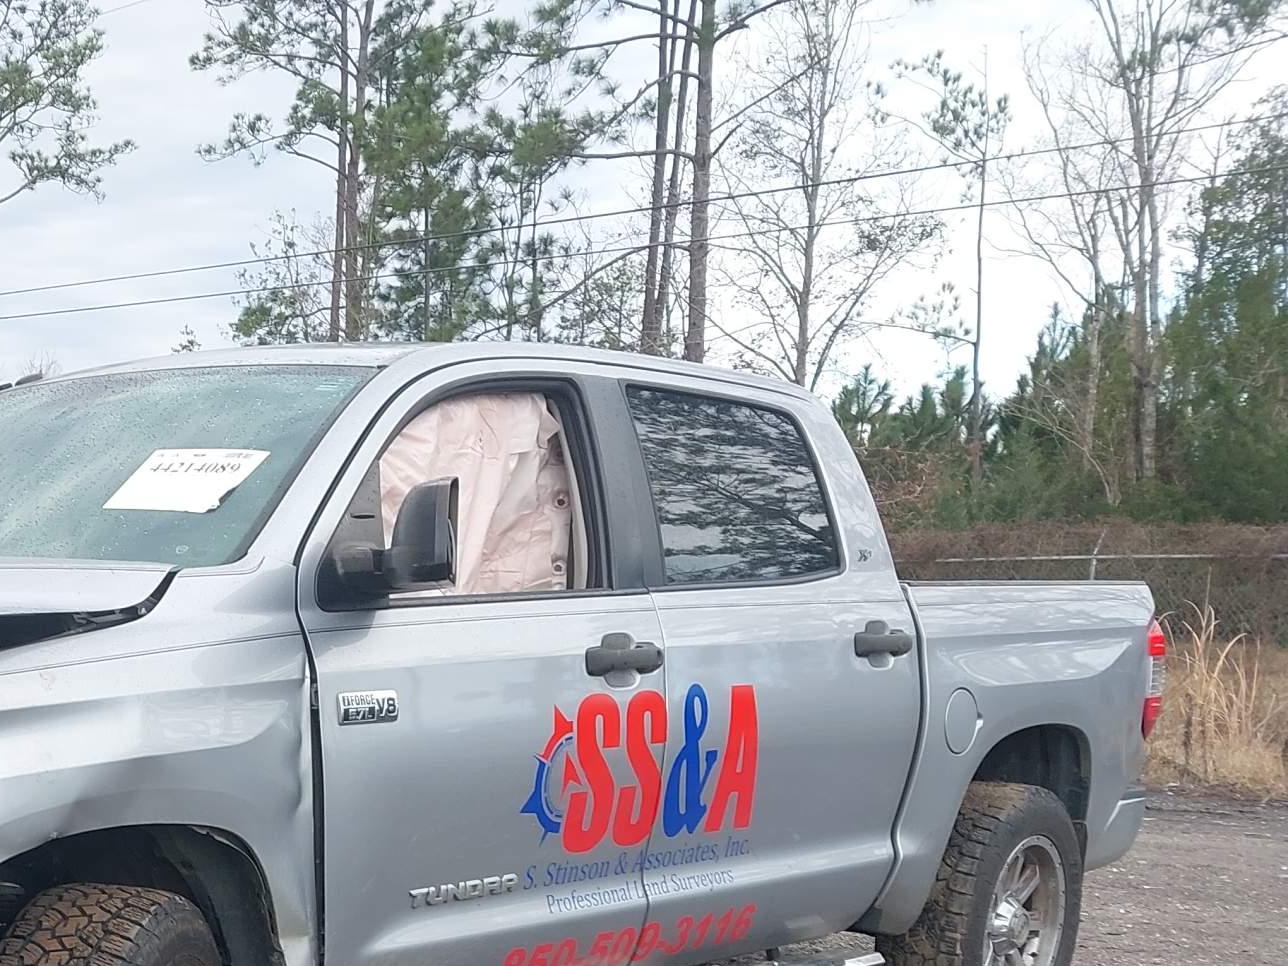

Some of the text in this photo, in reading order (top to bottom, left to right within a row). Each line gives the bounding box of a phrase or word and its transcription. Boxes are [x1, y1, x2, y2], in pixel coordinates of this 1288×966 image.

[150, 462, 241, 473] 44214089
[376, 696, 397, 716] V8
[561, 682, 759, 853] SS&A
[523, 835, 750, 890] S. Stinson & Associates, Inc.
[408, 873, 520, 909] TUNDRA
[546, 869, 734, 914] Professional Land Surveyors
